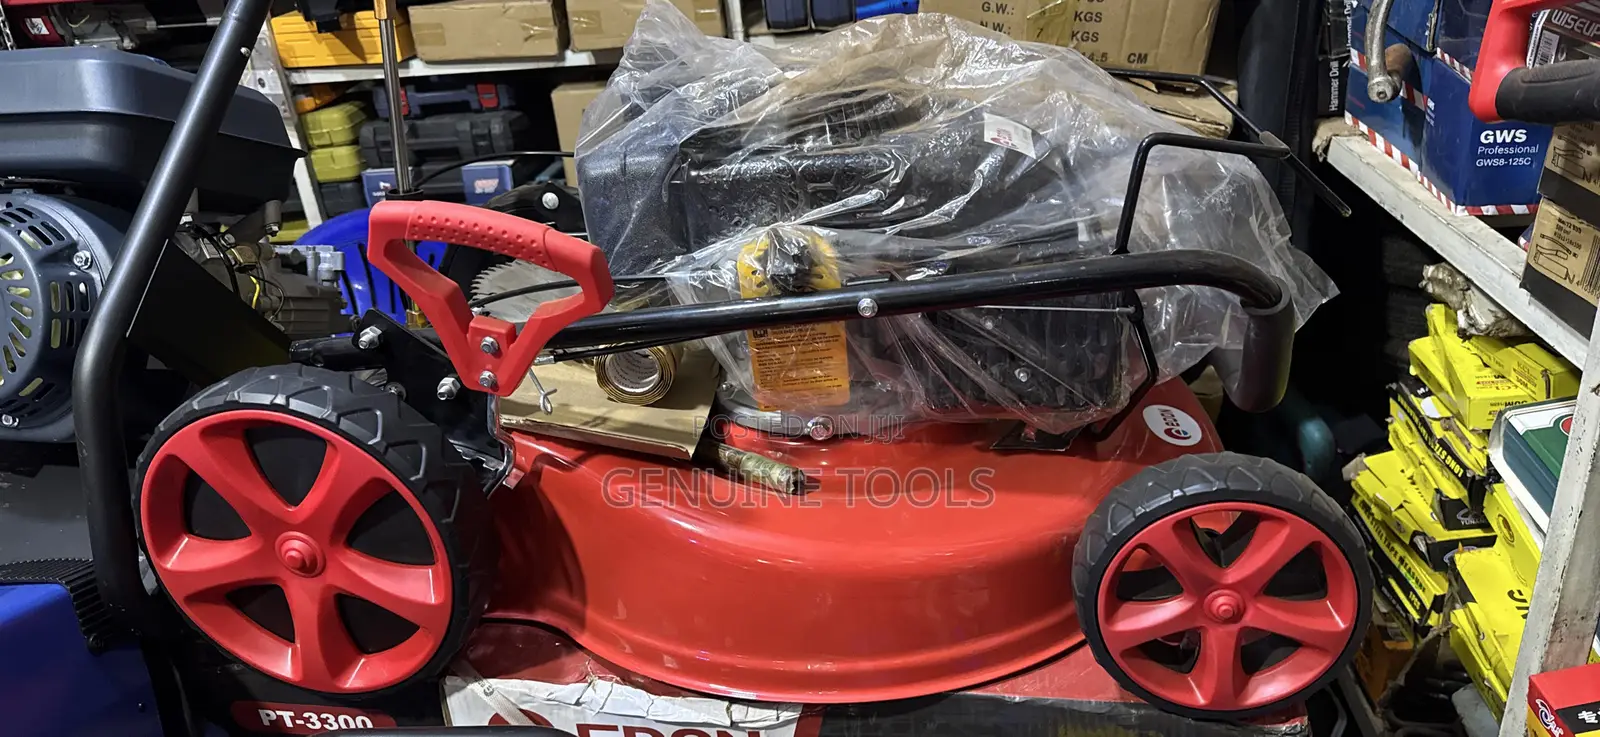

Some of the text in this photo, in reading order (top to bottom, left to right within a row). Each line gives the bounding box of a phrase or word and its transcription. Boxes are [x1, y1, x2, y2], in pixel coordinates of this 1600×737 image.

[981, 1, 1014, 15] G.W.:
[1074, 10, 1103, 23] KGS
[1070, 30, 1099, 42] KGS
[1127, 53, 1148, 64] CM
[1328, 60, 1339, 112] Hammer Drill
[1480, 129, 1527, 144] GWS
[1477, 144, 1539, 155] Professional
[1475, 157, 1532, 167] GWS8-125C
[1444, 455, 1464, 478] LONG
[258, 709, 373, 730] PT-3300
